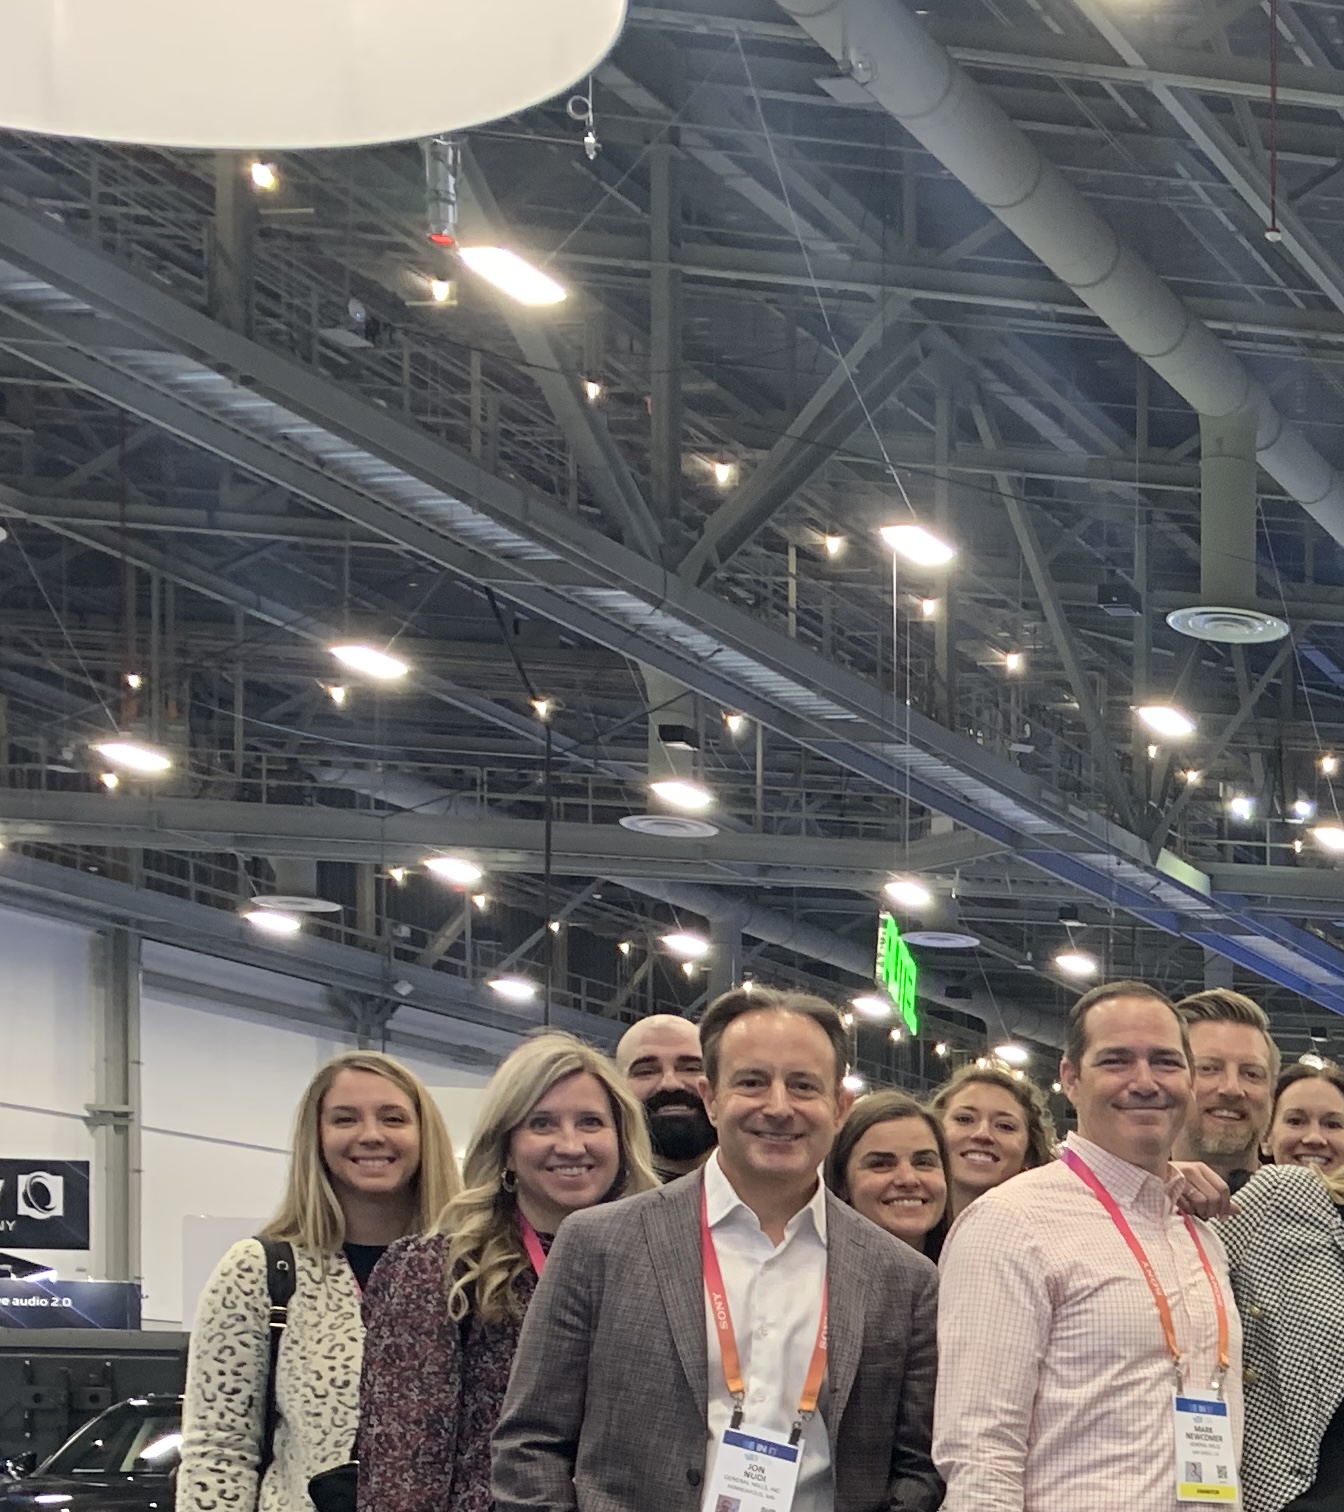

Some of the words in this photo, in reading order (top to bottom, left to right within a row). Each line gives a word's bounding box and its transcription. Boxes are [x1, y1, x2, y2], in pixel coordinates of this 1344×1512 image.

[12, 1296, 48, 1307] audio
[51, 1297, 71, 1307] 2.0
[713, 1292, 728, 1330] SONY
